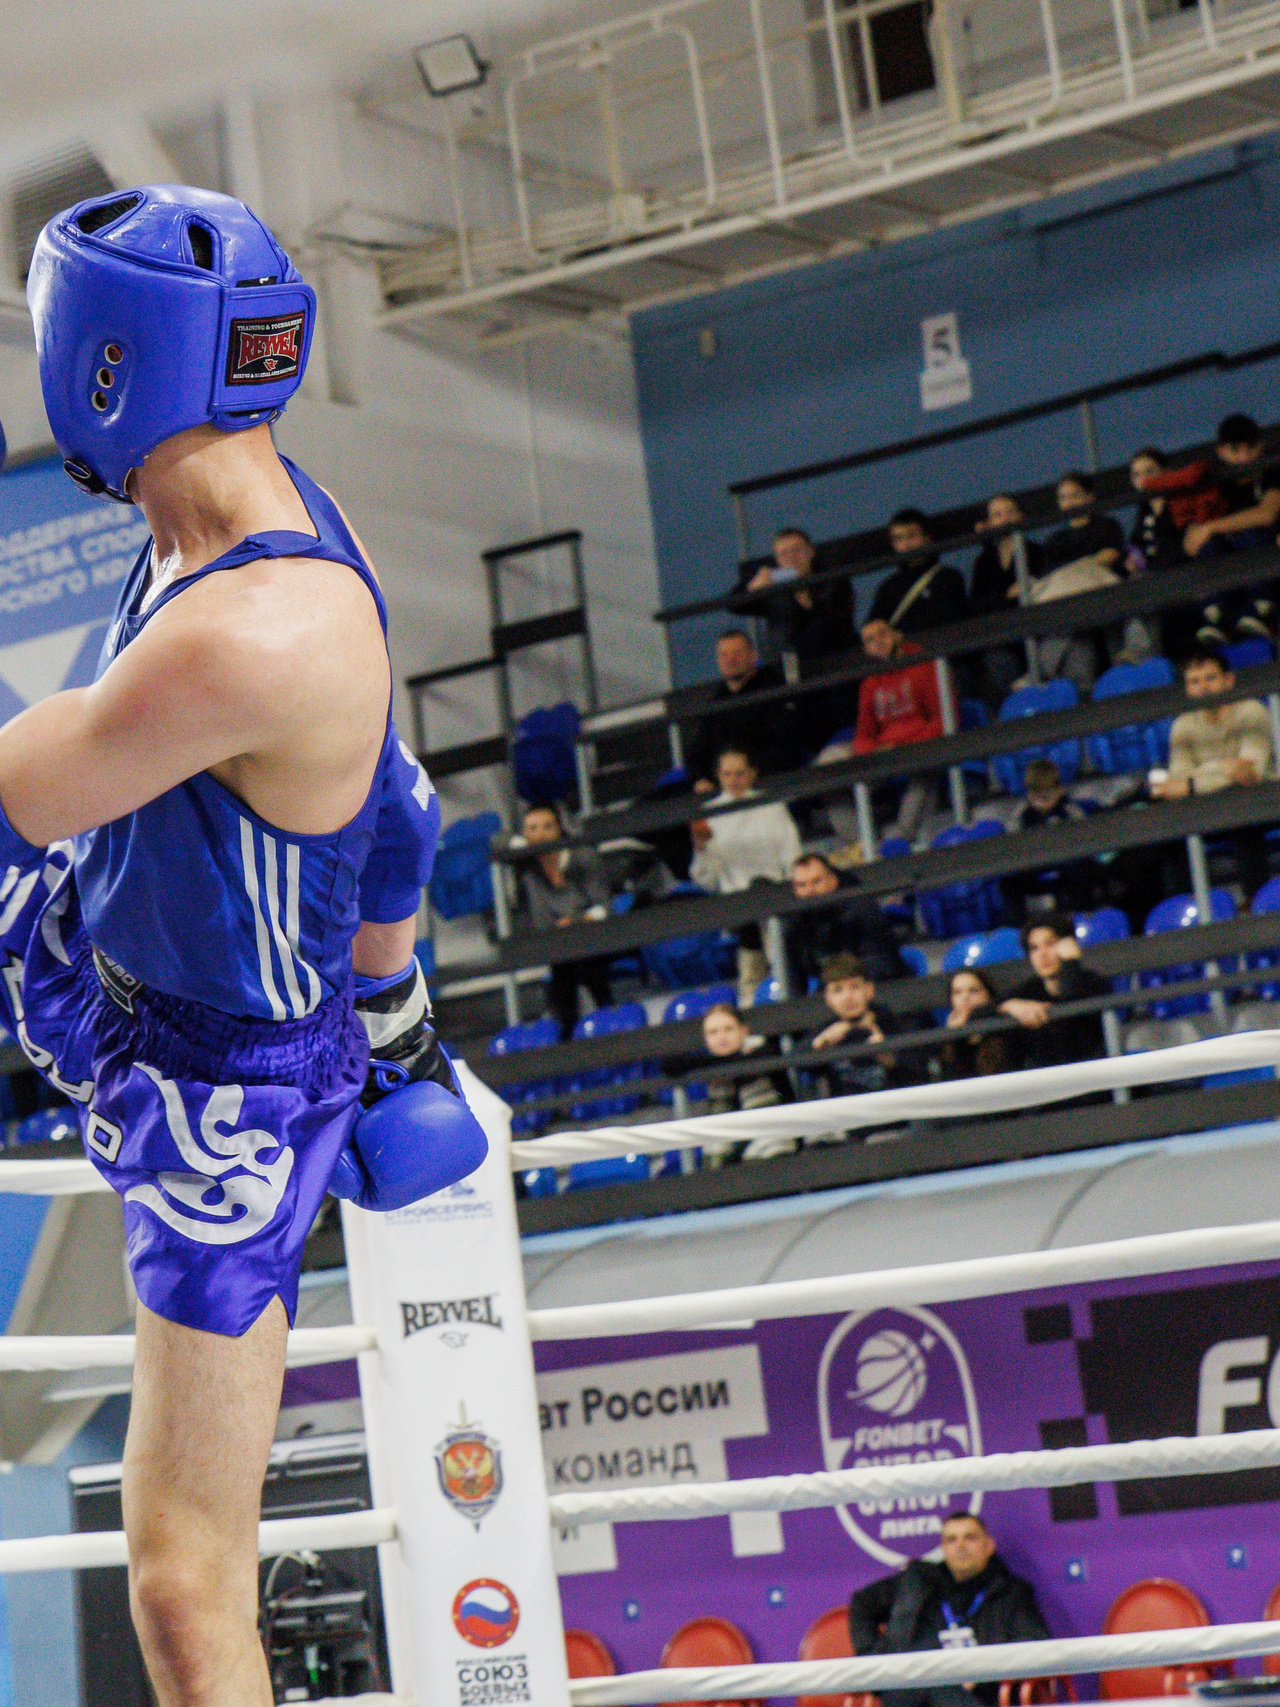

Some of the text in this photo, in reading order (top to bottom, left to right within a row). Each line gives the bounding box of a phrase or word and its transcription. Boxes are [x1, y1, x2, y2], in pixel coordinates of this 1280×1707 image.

[238, 328, 298, 369] REYVEL
[400, 1295, 505, 1340] REYVEL
[581, 1378, 731, 1425] России
[1197, 1335, 1280, 1435] F
[854, 1418, 946, 1451] FONBET
[553, 1441, 699, 1485] команд
[458, 1663, 529, 1684] СОЮЗ
[460, 1681, 529, 1697] БОЕВЫХ
